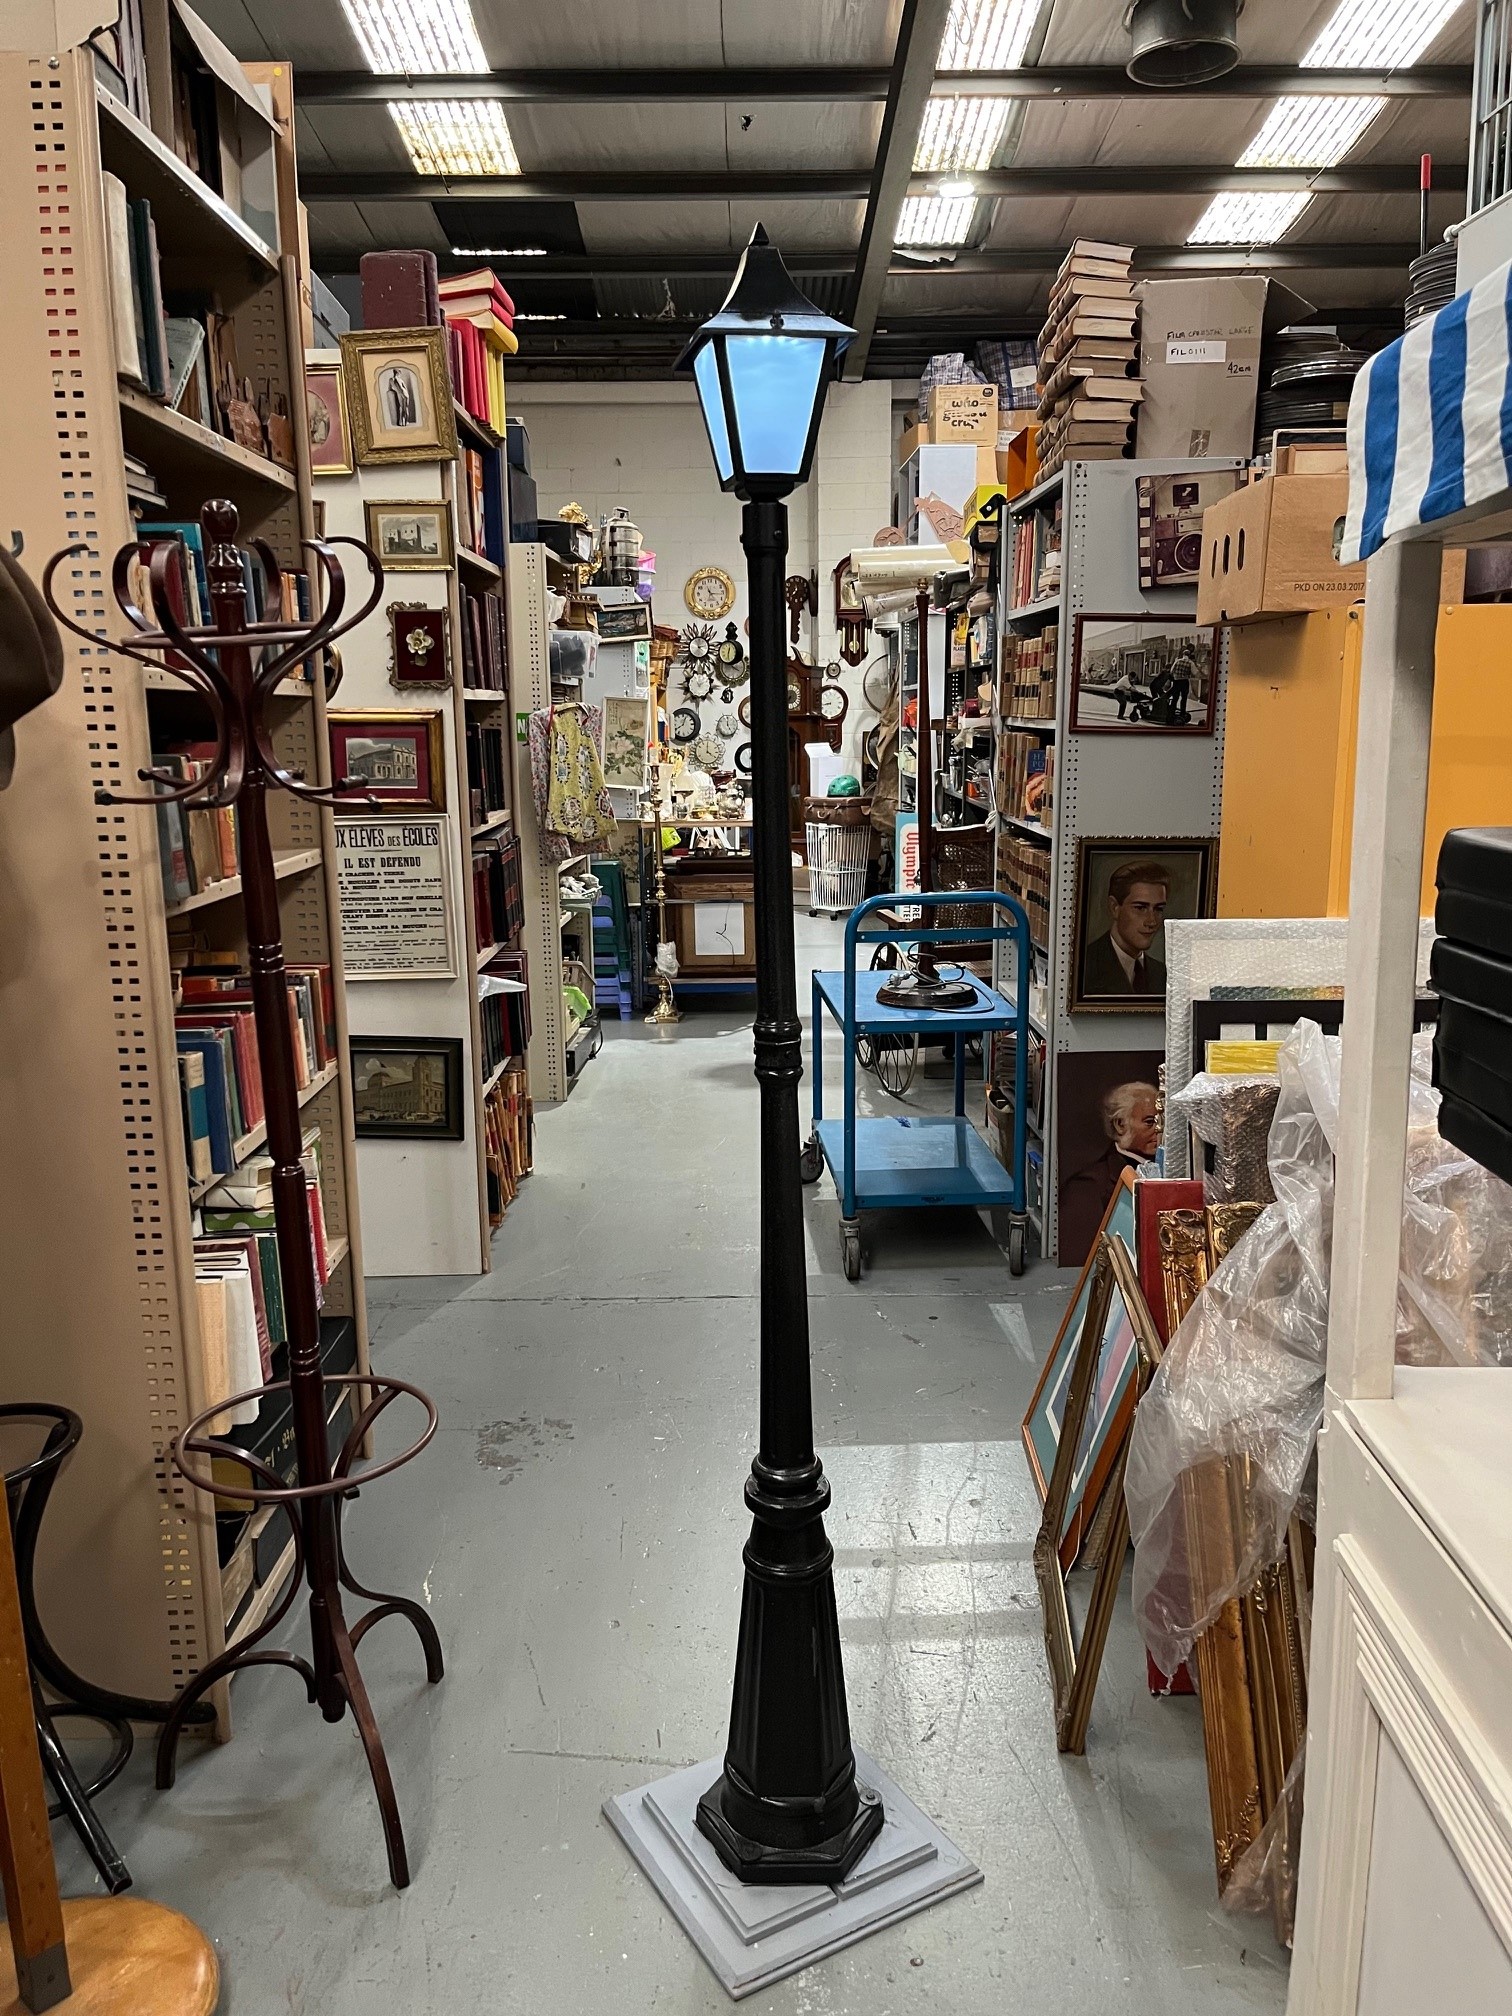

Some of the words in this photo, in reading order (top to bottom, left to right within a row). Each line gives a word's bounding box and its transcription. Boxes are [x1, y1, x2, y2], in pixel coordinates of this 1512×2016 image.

[1167, 331, 1186, 340] FILM
[1294, 583, 1310, 591] PKD
[1312, 583, 1324, 591] ON
[1326, 583, 1365, 591] 23.03.2017
[387, 836, 401, 847] DES
[343, 858, 353, 869] IL
[358, 858, 375, 868] EST
